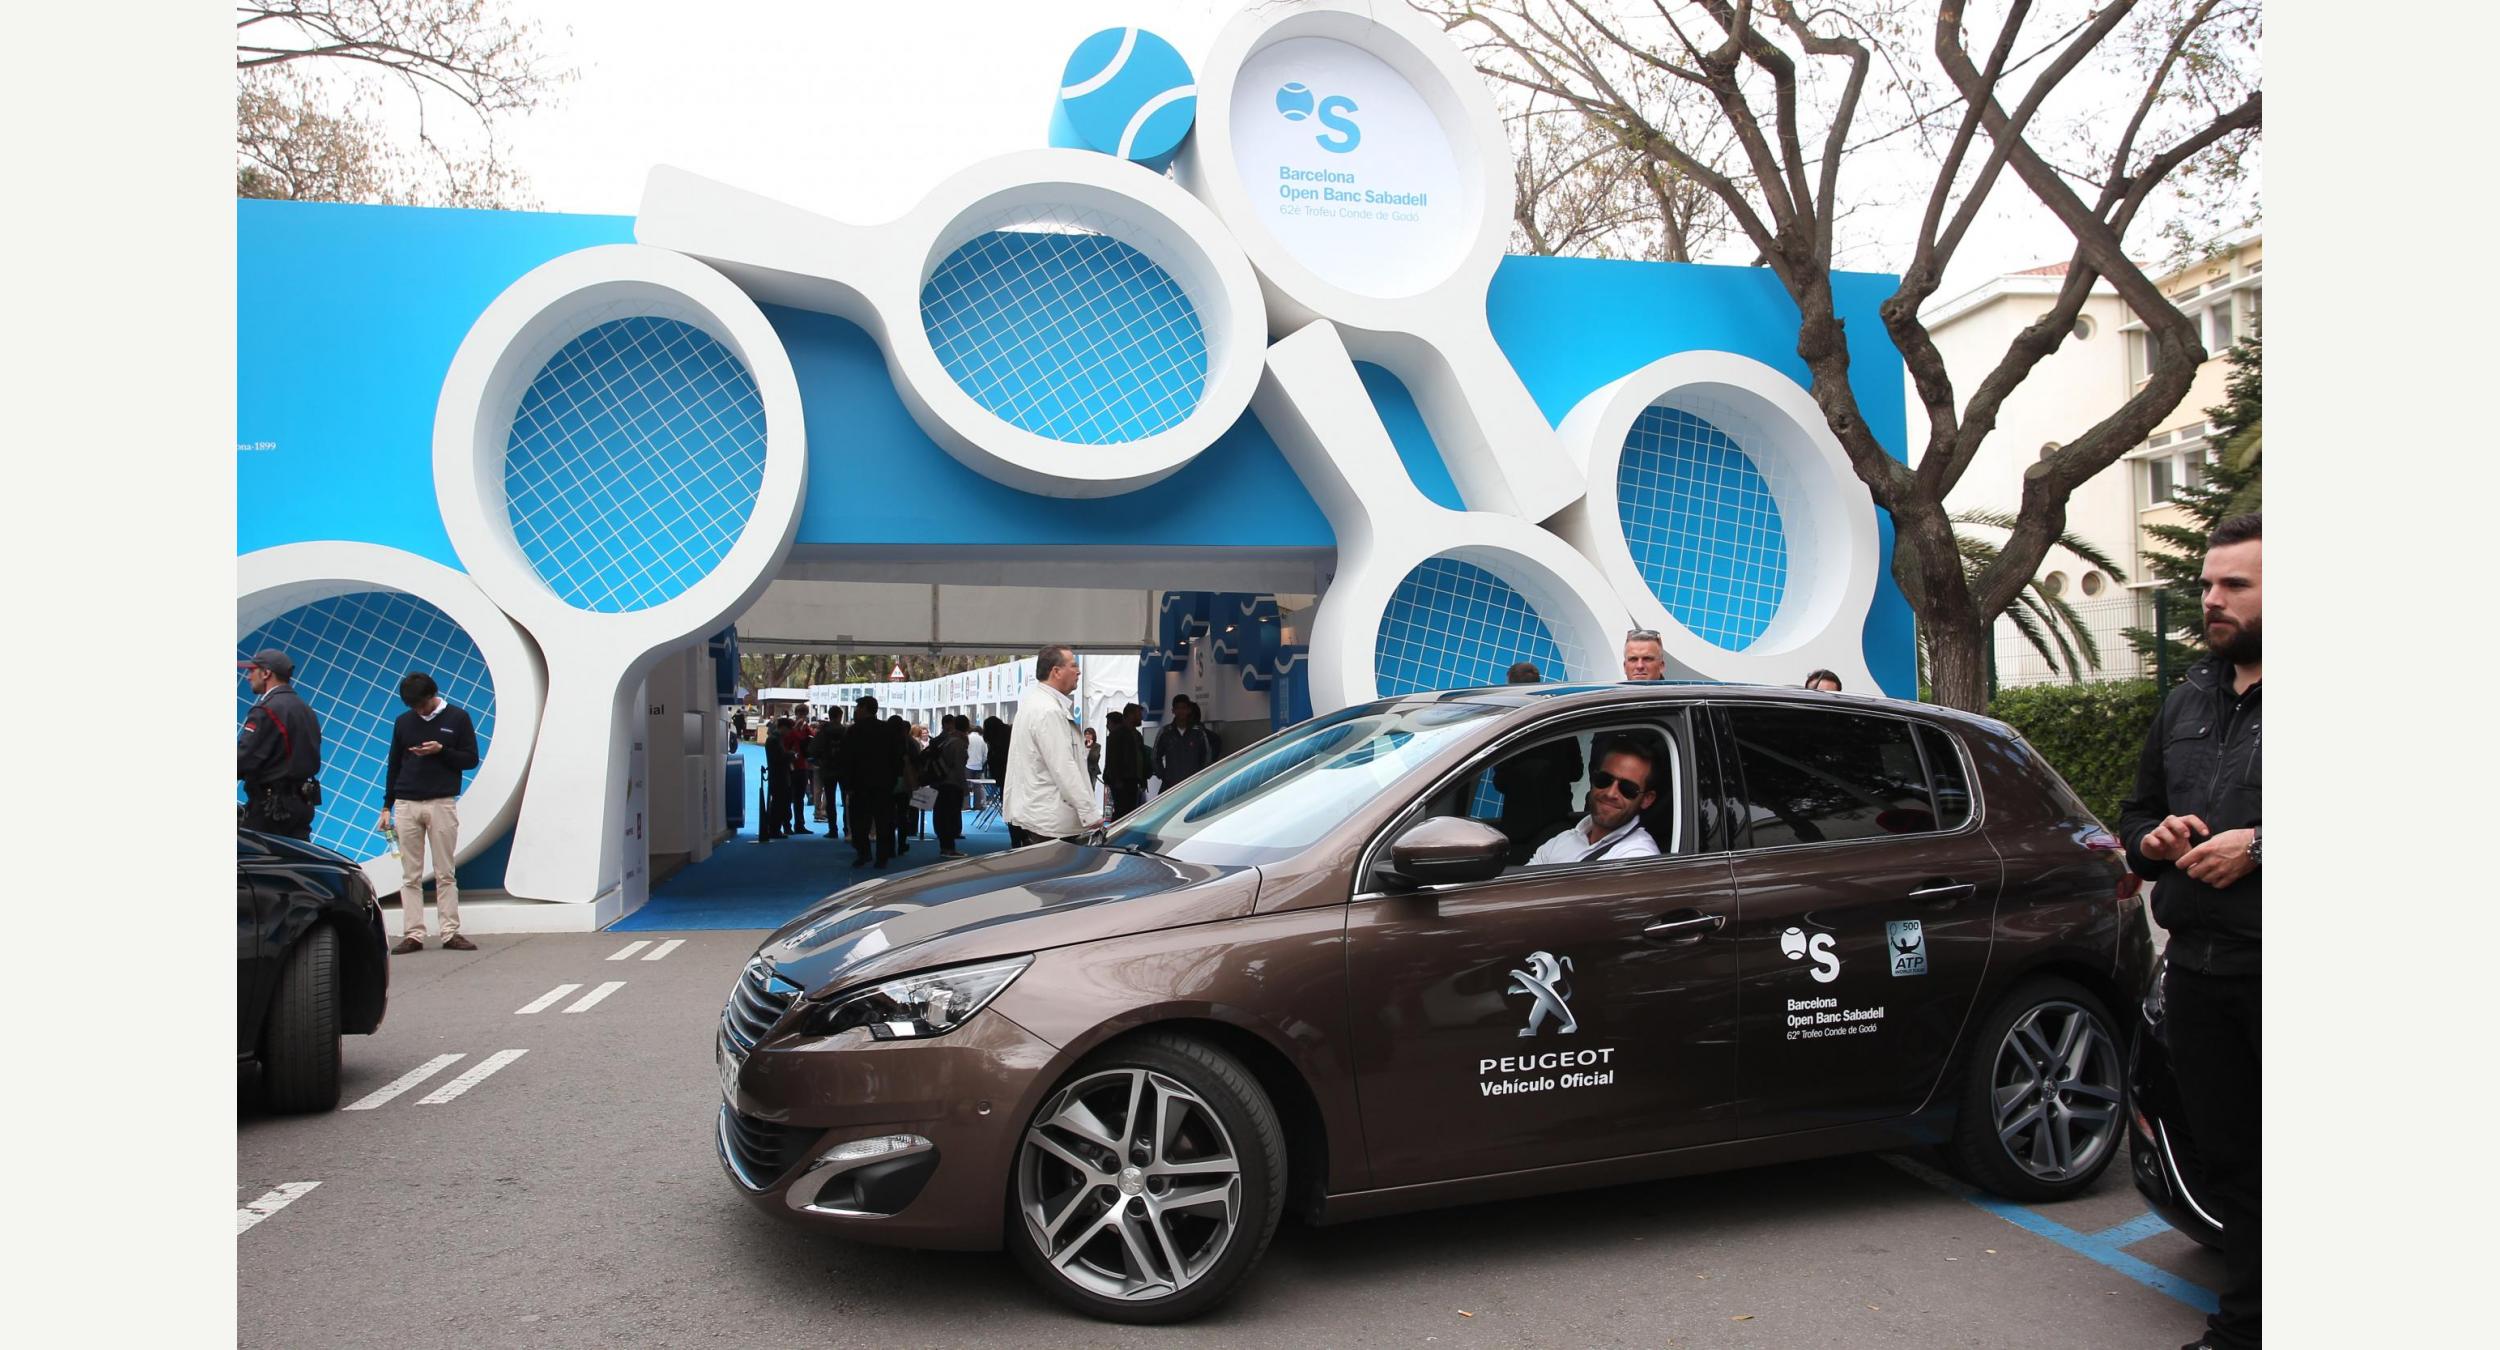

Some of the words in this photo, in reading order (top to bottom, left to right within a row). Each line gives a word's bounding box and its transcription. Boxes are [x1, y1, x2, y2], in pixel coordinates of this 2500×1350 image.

[1279, 166, 1355, 184] Barcelona
[1279, 184, 1319, 201] Open
[1323, 187, 1362, 203] Banc
[1365, 189, 1427, 207] Sabadell
[1305, 206, 1336, 217] Trofeu
[1339, 208, 1372, 220] Conde
[1376, 211, 1389, 220] de
[1903, 922, 1919, 931] 500
[1895, 957, 1924, 970] ATP
[1787, 997, 1837, 1011] Barcelona
[1787, 1013, 1814, 1028] Open
[1816, 1010, 1841, 1024] Banc
[1842, 1007, 1884, 1021] Sabadell
[1802, 1028, 1823, 1039] Trofeo
[1824, 1026, 1847, 1036] Conde
[1848, 1026, 1857, 1034] de
[1859, 1023, 1877, 1034] Godó
[1480, 1048, 1615, 1074] PEUGEOT
[1480, 1076, 1555, 1097] Vehículo
[1560, 1070, 1614, 1089] Oficial
